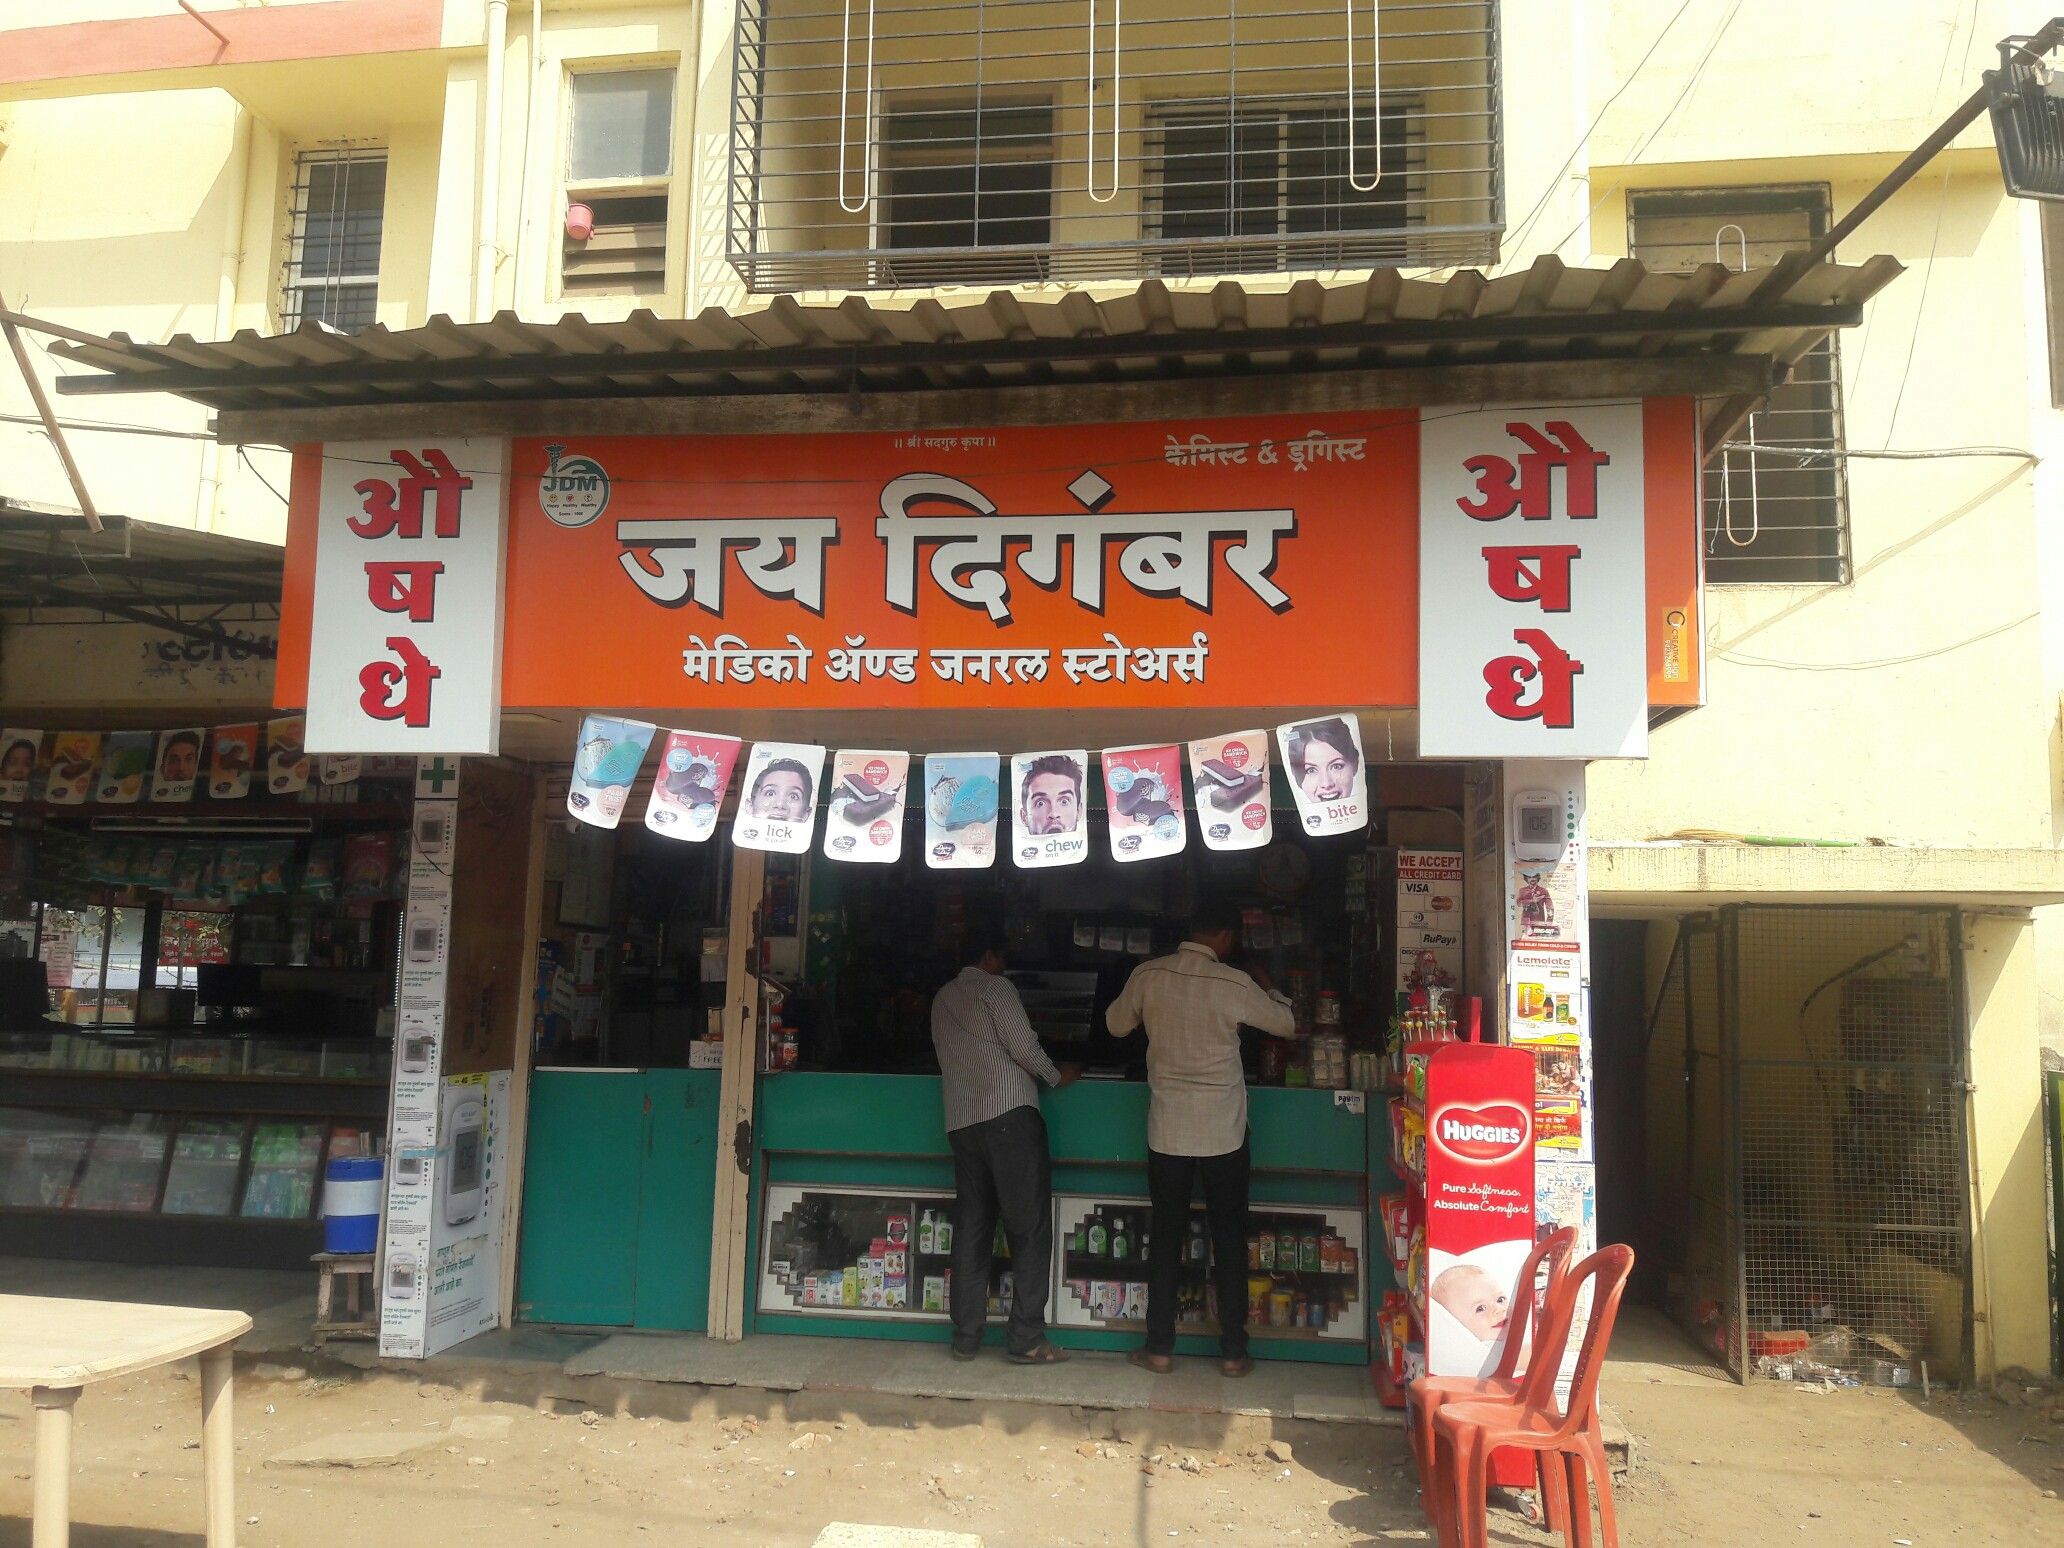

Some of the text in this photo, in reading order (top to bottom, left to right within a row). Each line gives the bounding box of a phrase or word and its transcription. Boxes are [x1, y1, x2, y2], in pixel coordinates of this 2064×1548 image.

[907, 435, 921, 449] श्री
[924, 437, 958, 452] सदगुरु
[961, 436, 985, 451] कृपा
[1163, 433, 1248, 466] केमिस्ट
[1257, 440, 1278, 465] &
[543, 476, 598, 493] JDM
[617, 469, 1298, 627] जय दिगंबर
[682, 633, 813, 685] मेडिको
[930, 647, 1050, 687] जनरल
[1062, 630, 1210, 686] स्टोअर्स
[1327, 805, 1358, 819] bite
[766, 825, 793, 839] lick
[1045, 839, 1083, 852] chew
[1400, 855, 1461, 868] WE ACCEPT
[1400, 870, 1462, 880] ALL CREDIT CARD
[1406, 883, 1429, 893] VISA
[1423, 934, 1454, 946] RuPay
[1517, 956, 1571, 965] Lemolate
[1443, 1120, 1520, 1144] HUGGIES
[1442, 1183, 1467, 1193] Pure
[1434, 1200, 1530, 1218] Absolute Comfort
